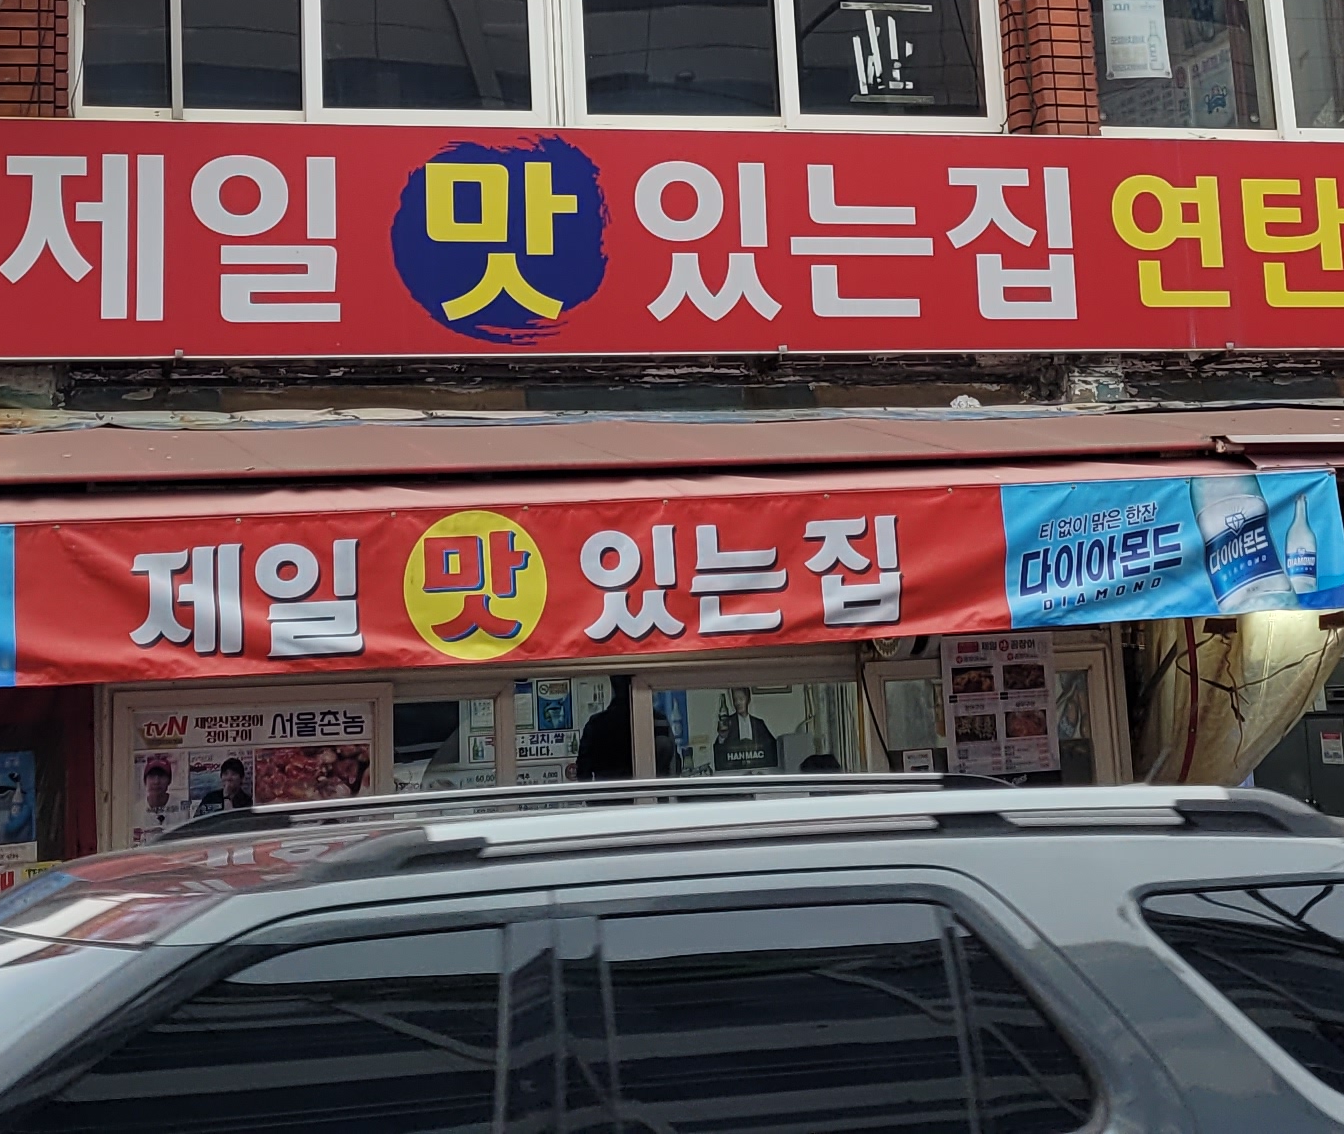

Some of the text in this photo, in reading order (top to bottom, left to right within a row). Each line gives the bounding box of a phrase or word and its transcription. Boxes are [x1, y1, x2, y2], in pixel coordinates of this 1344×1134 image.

[424, 159, 579, 322] 맛
[633, 159, 1078, 323] 있는집
[1039, 501, 1158, 541] 티 없이 맑은 한잔
[1018, 522, 1183, 597] 다이아몬드
[1208, 526, 1270, 574] 다이아몬드
[130, 537, 365, 658] 제일
[422, 529, 531, 642] 맛
[1043, 577, 1163, 611] DIAMOND
[144, 716, 188, 738] tvN
[268, 710, 366, 739] 서울촌놈
[727, 750, 765, 762] HANMAC
